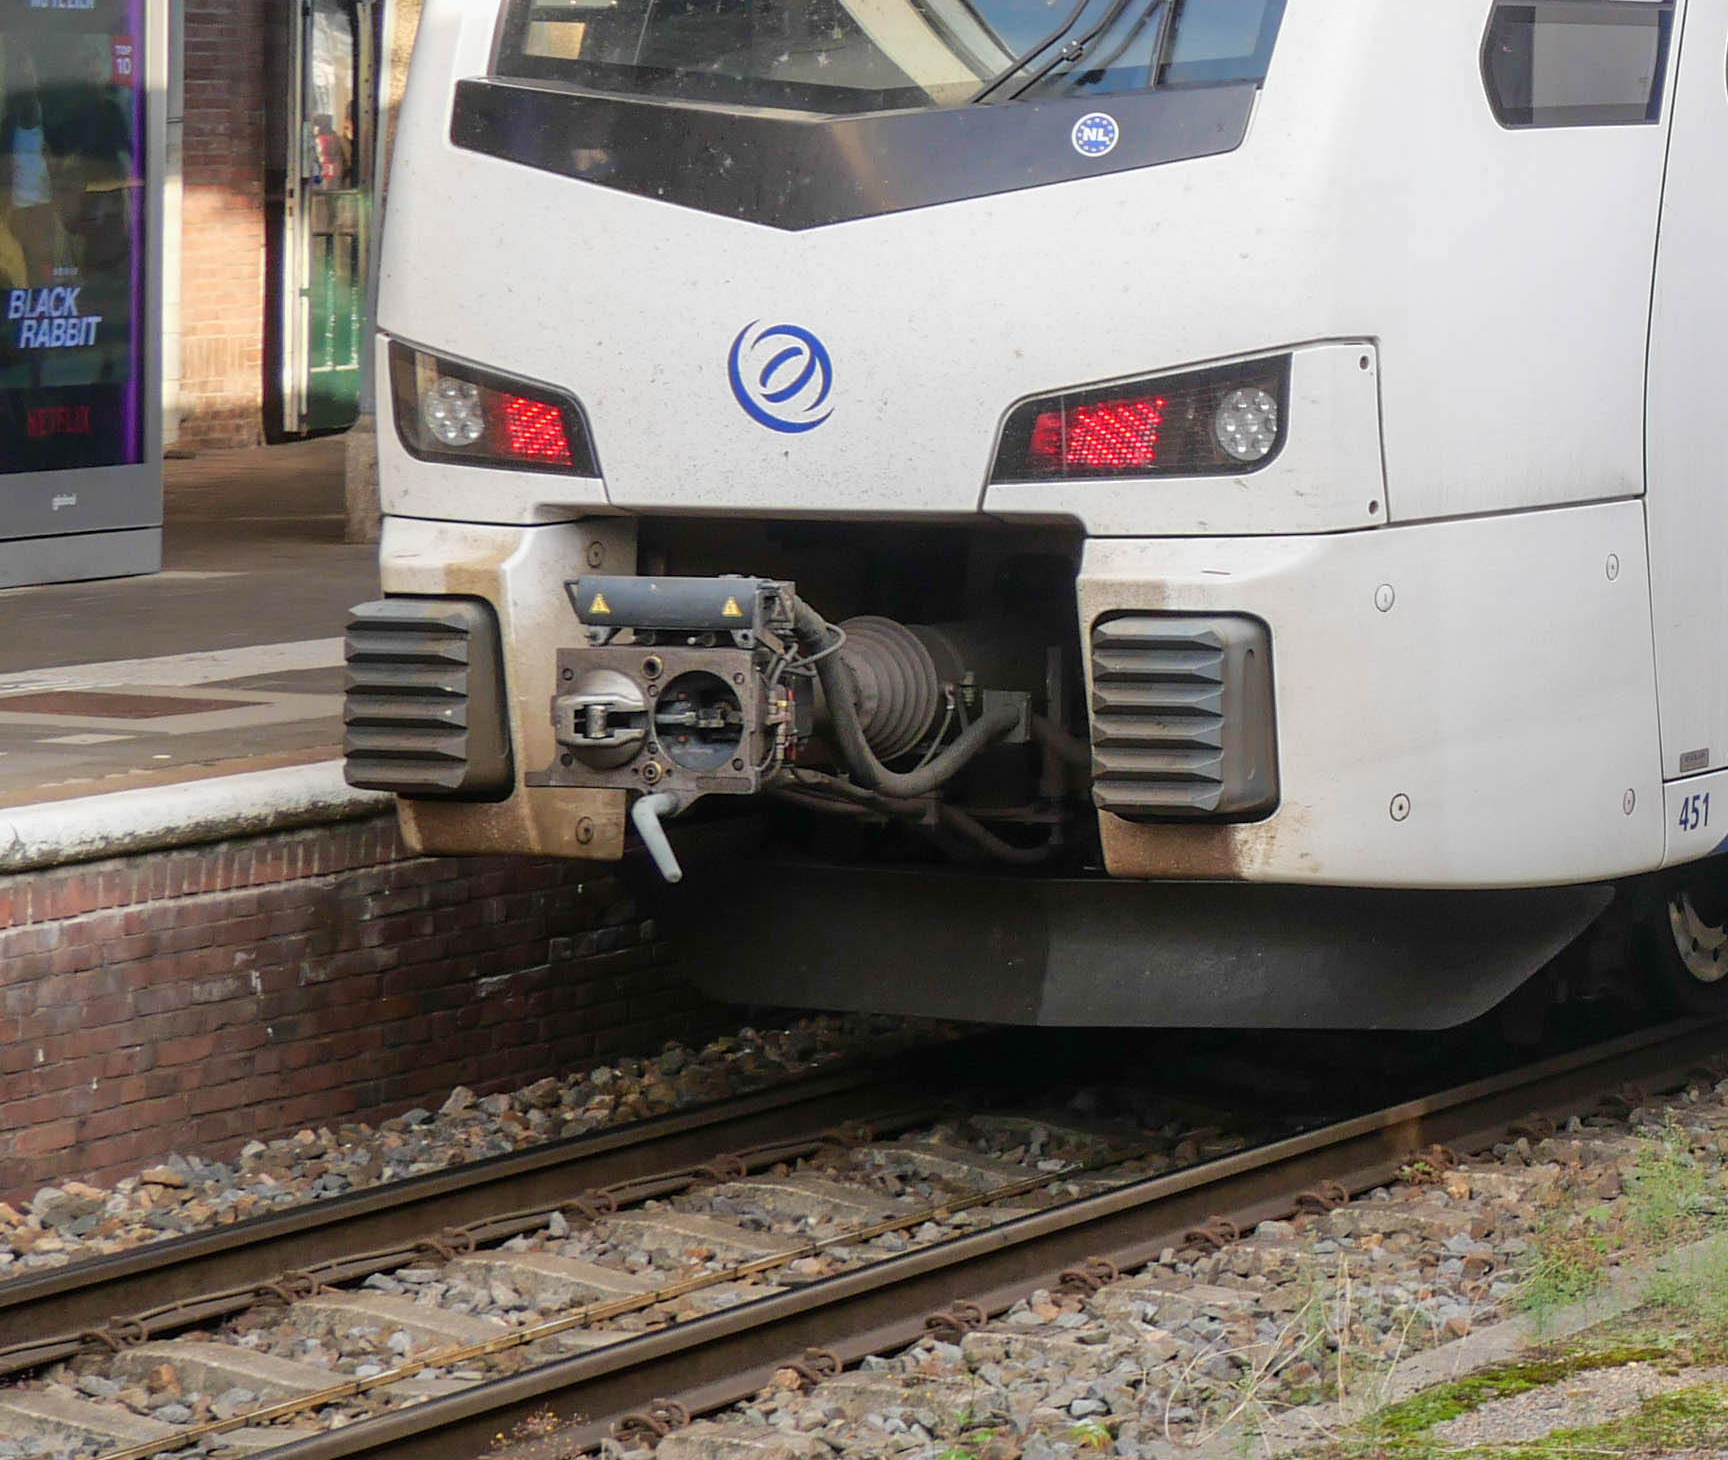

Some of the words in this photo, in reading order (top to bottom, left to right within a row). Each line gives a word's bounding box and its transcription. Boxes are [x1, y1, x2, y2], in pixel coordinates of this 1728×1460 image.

[116, 57, 132, 75] 10
[1082, 127, 1109, 142] NL
[8, 286, 81, 320] BLACK
[19, 316, 103, 349] RABBIT
[1679, 792, 1710, 832] 451
